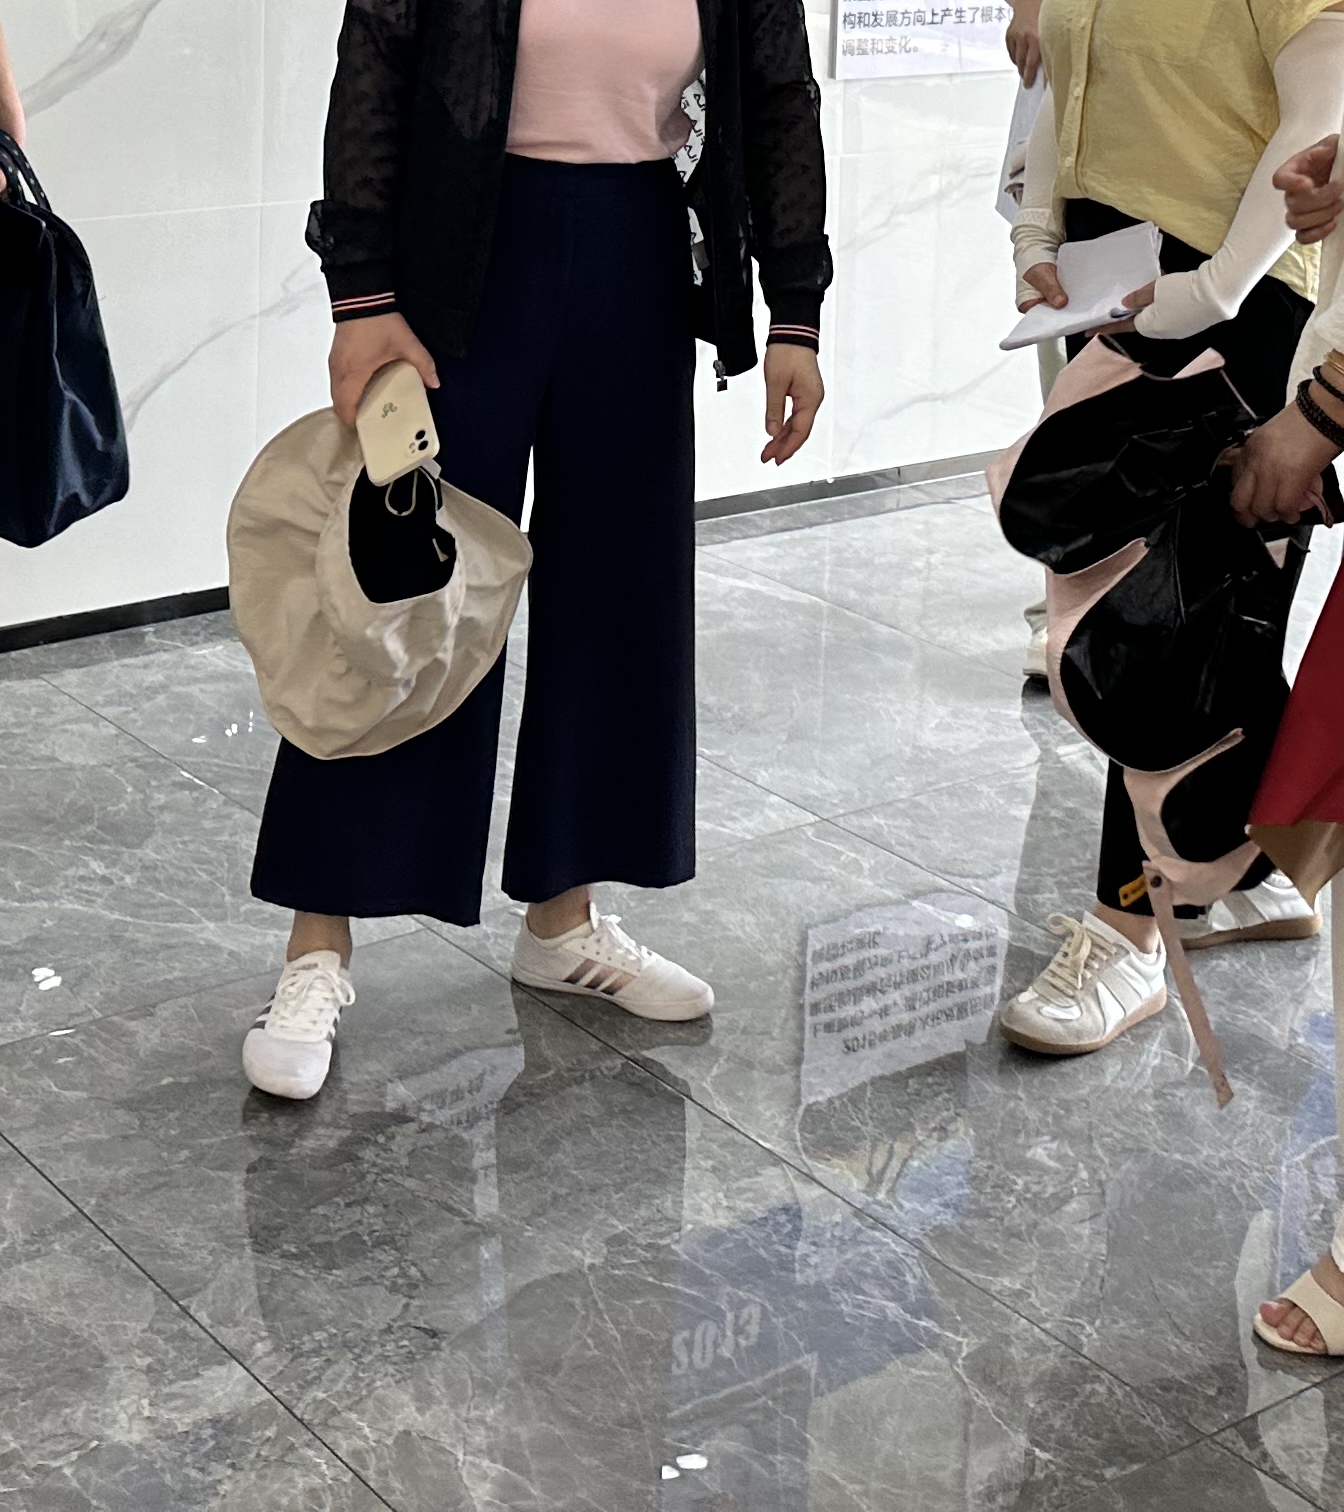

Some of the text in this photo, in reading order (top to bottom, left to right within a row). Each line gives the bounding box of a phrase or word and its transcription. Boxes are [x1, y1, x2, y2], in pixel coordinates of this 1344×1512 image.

[842, 5, 1012, 30] 构和发展方向上产生了根本
